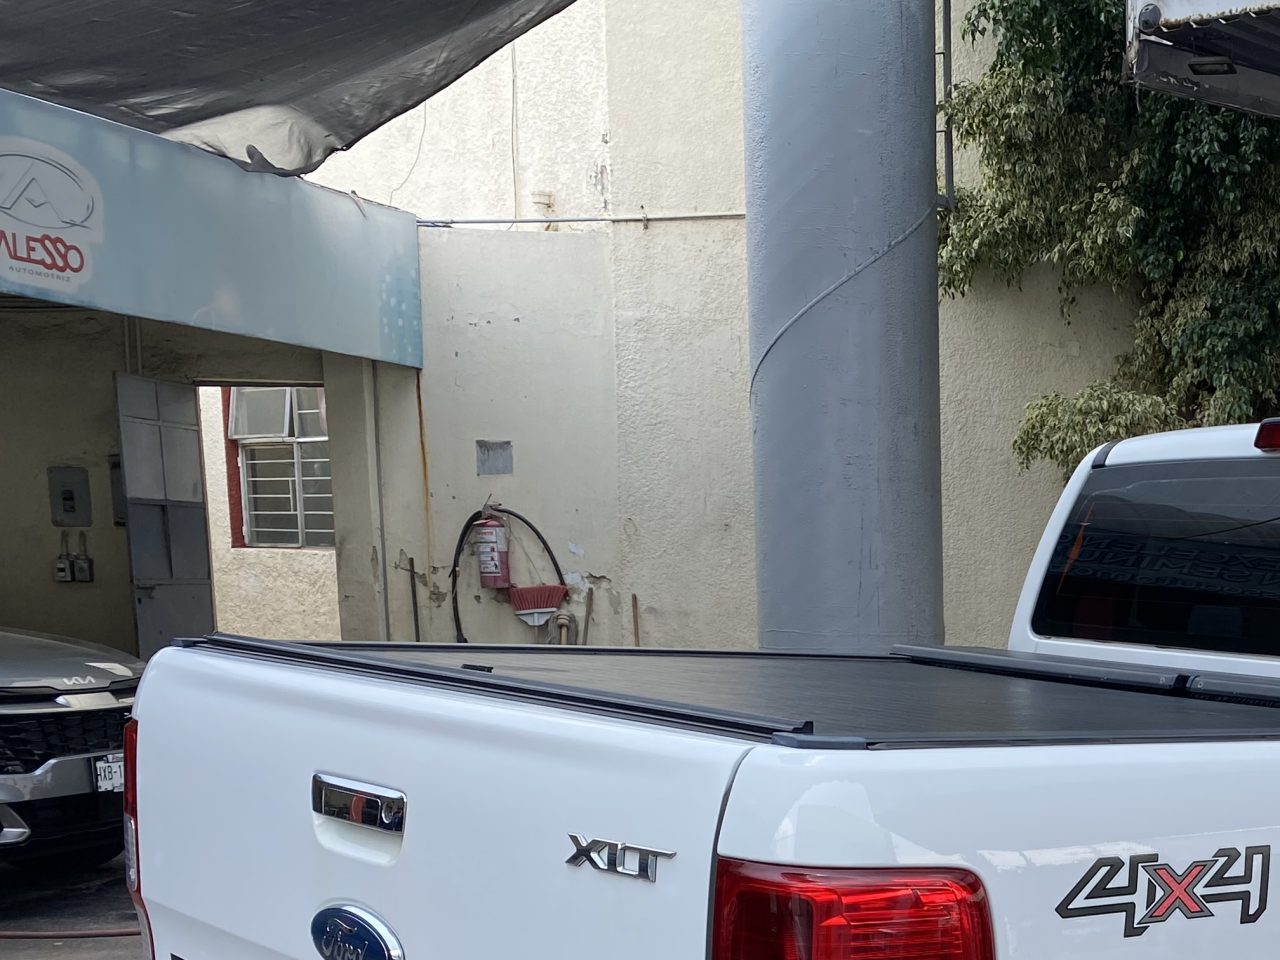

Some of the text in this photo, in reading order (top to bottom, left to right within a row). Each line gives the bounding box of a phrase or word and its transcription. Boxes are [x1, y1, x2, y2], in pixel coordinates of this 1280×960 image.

[0, 229, 84, 273] ALESSO
[8, 265, 71, 282] AUTOMOTRIZ
[565, 832, 677, 883] XLT
